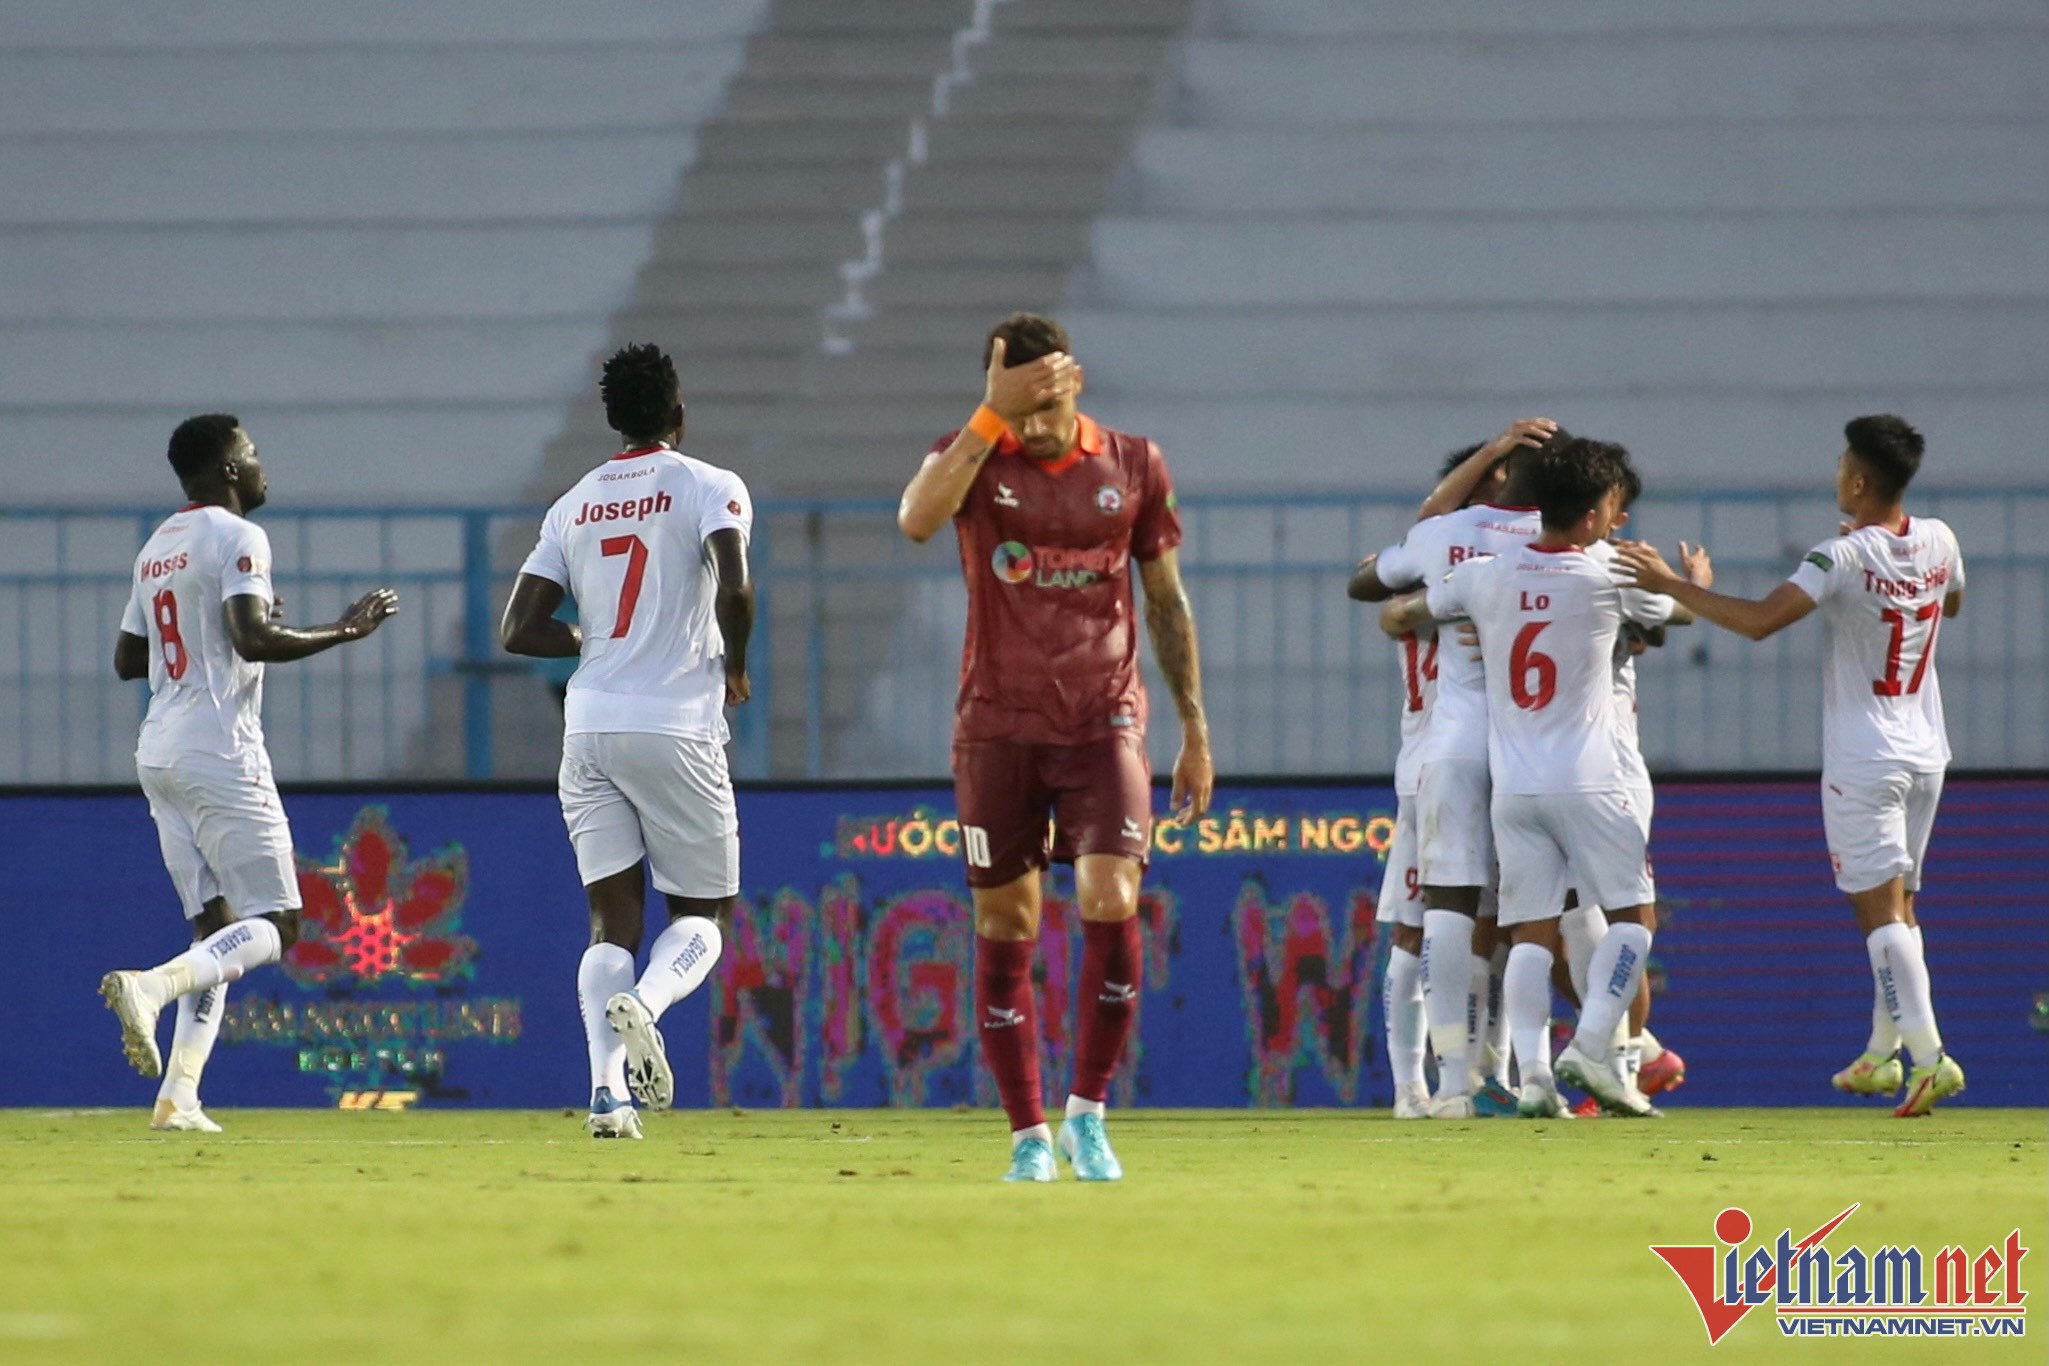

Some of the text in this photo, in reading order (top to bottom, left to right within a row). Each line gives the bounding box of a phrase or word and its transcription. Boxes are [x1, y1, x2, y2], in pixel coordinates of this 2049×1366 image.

[575, 491, 672, 525] Joseph
[1449, 546, 1497, 566] Ri
[600, 534, 649, 639] 7
[1036, 570, 1099, 588] LAND
[1520, 591, 1550, 610] Lo
[152, 588, 188, 681] 8
[1872, 600, 1940, 696] 17
[1509, 621, 1557, 712] 6
[963, 825, 991, 868] 10
[1301, 817, 1396, 861] NGỌ
